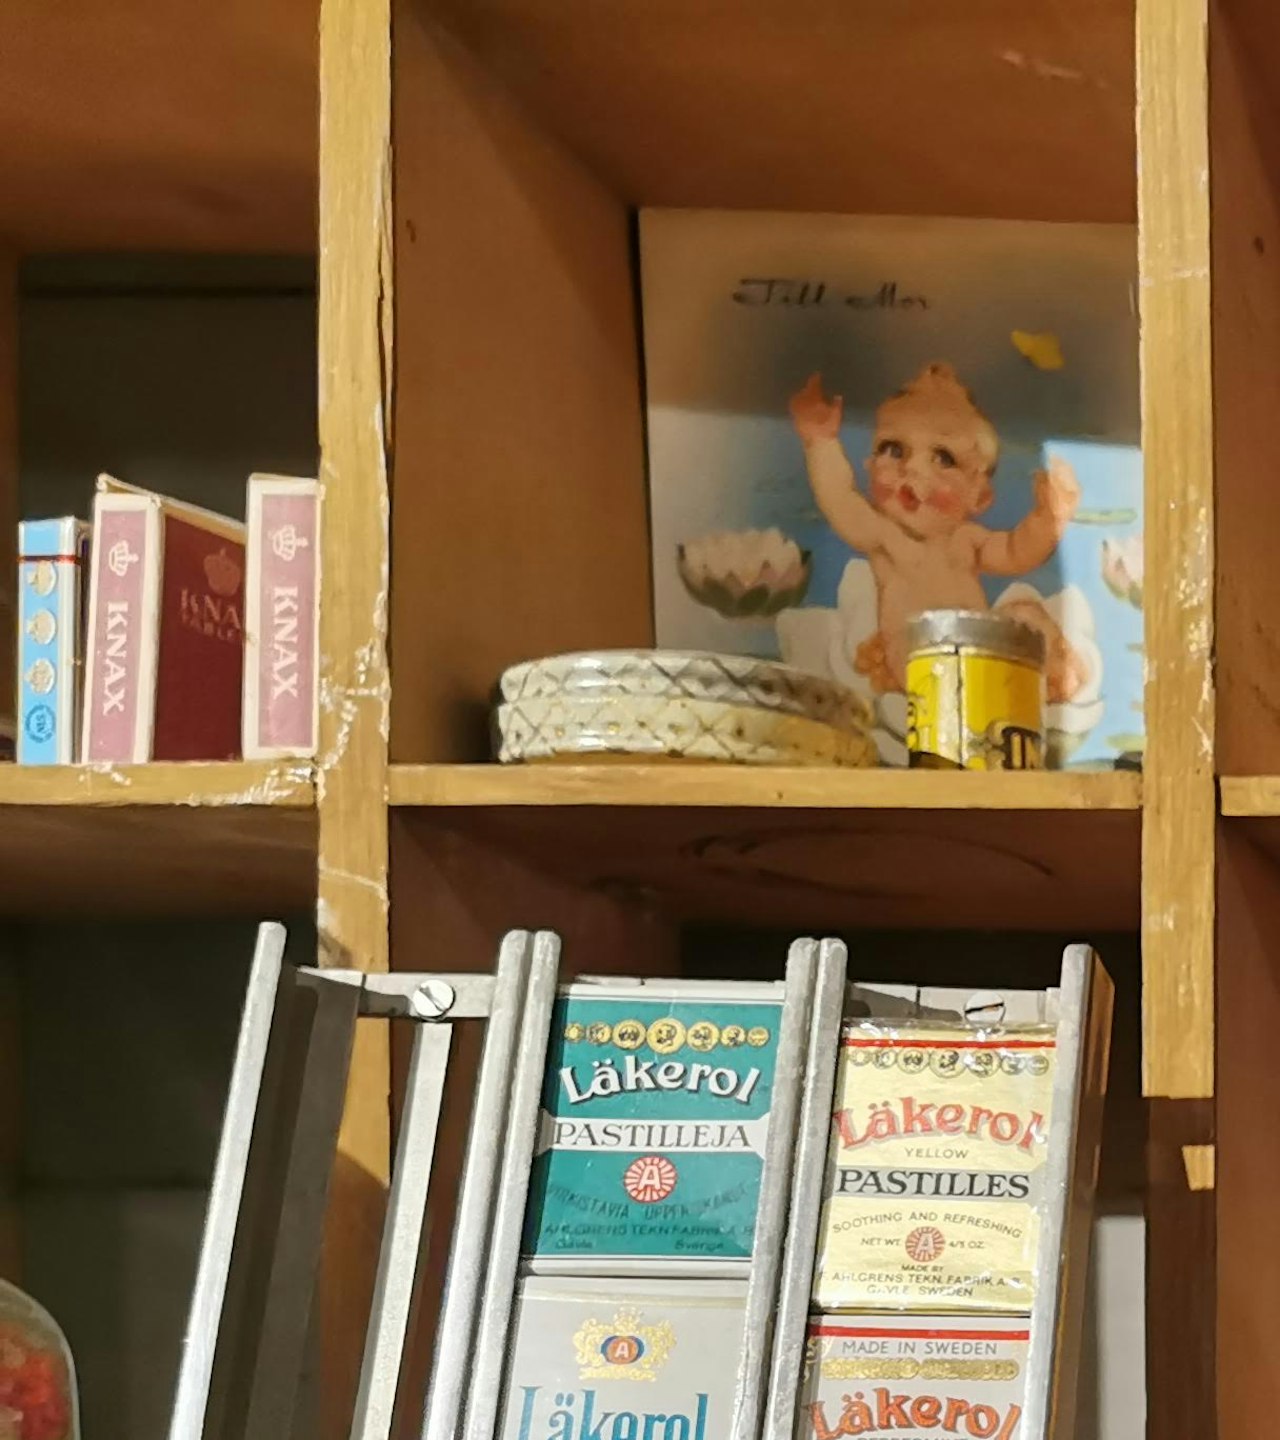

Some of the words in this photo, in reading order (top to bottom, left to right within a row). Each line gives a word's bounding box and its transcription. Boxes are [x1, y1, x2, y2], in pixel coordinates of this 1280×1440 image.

[103, 601, 129, 716] KNAX
[272, 586, 299, 700] KNAX
[560, 1055, 761, 1105] Läkerol
[554, 1121, 752, 1149] PASTILLEJA
[832, 1096, 1045, 1152] Läkerol
[904, 1147, 969, 1160] YELLOW
[837, 1168, 1031, 1199] PASTILLES
[833, 1211, 903, 1234] SOOTHING
[909, 1211, 938, 1222] AND
[944, 1212, 1023, 1239] REFRESHING
[842, 1341, 888, 1354] MADE
[898, 1342, 916, 1354] IN
[924, 1342, 998, 1355] SWEDEN
